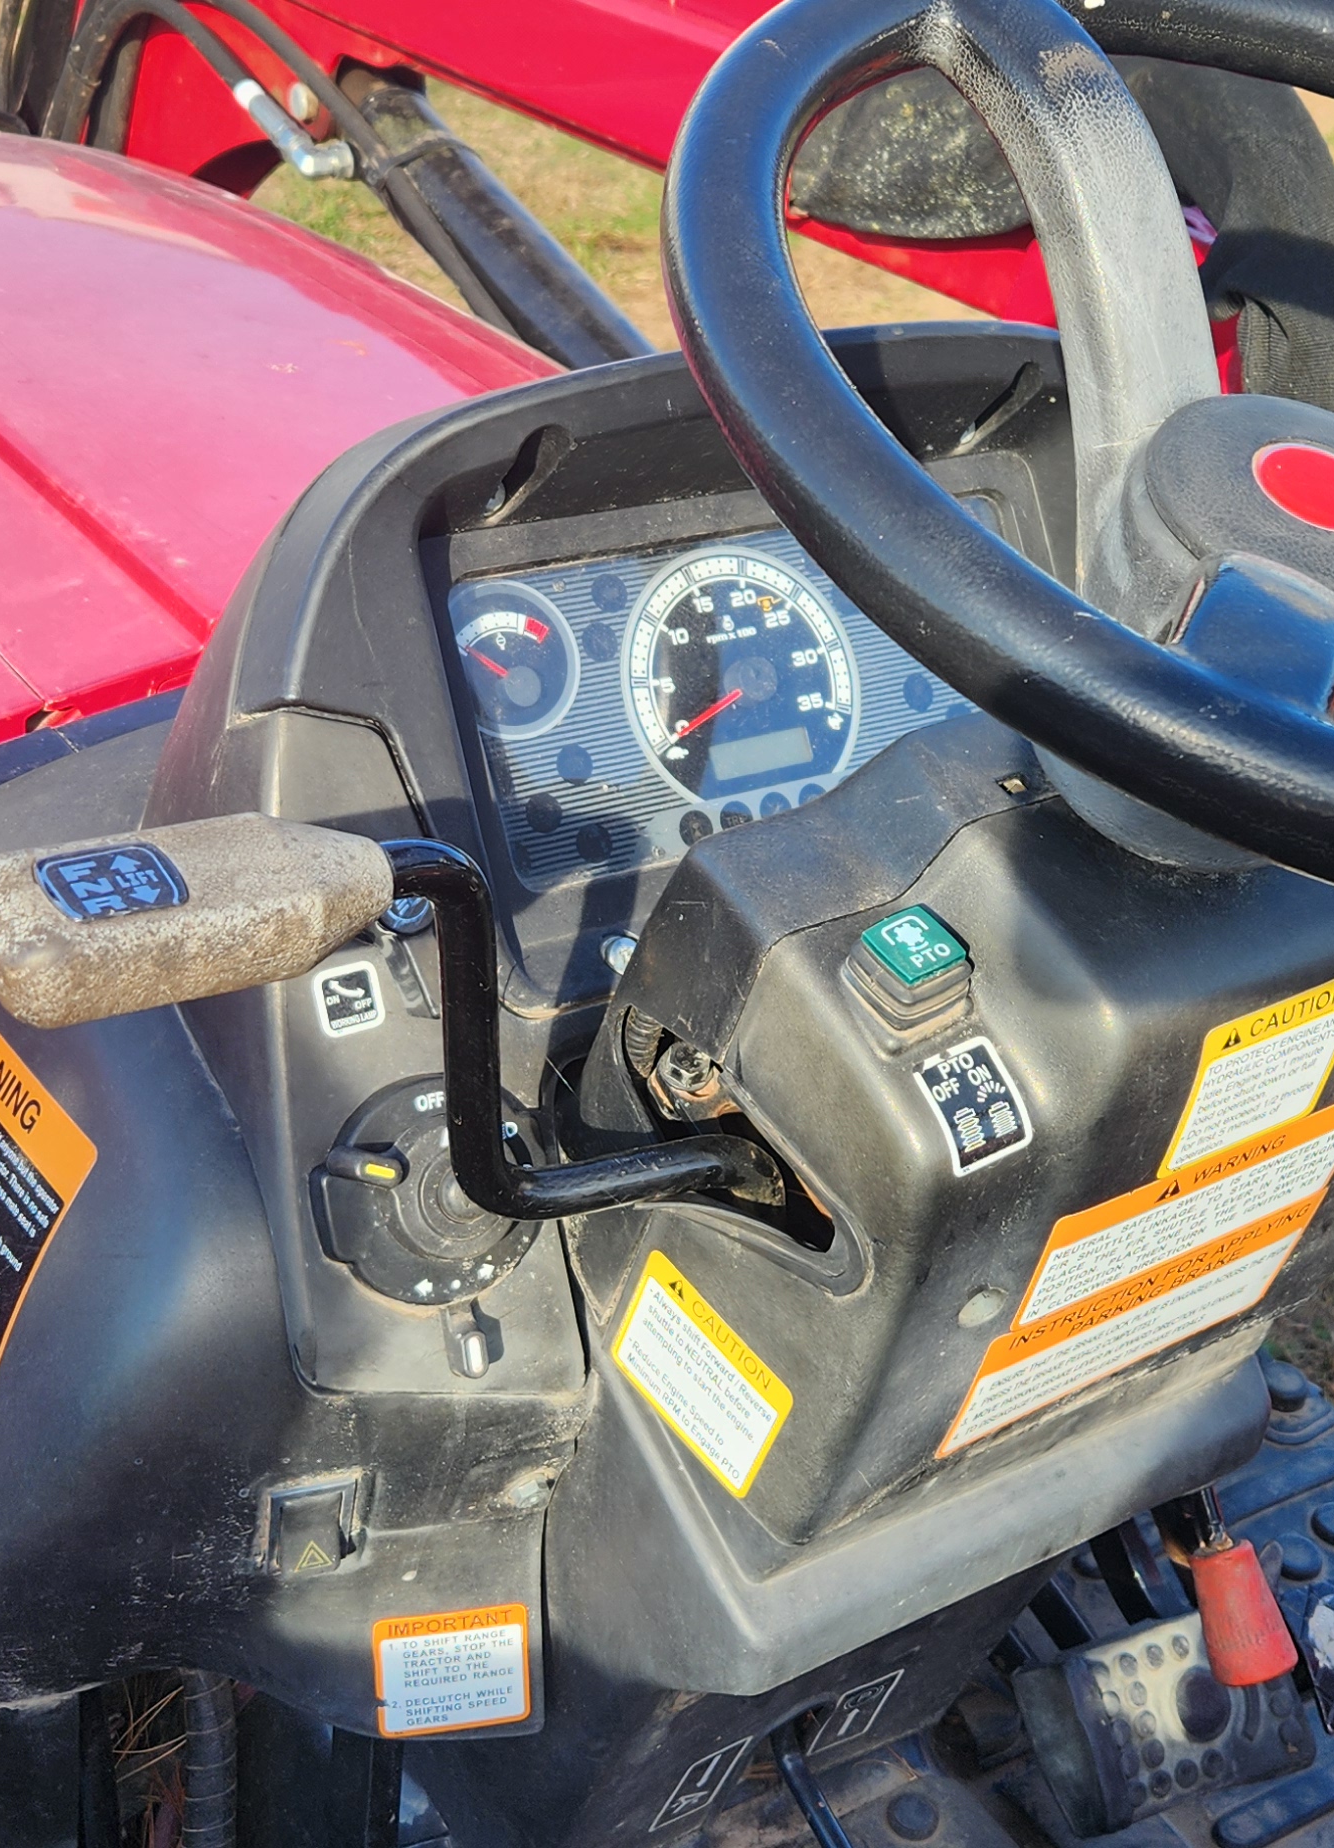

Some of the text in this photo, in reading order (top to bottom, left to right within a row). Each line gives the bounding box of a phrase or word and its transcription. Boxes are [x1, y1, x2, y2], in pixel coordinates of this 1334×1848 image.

[692, 596, 714, 613] 15
[729, 589, 757, 607] 20
[764, 609, 791, 628] 25
[668, 628, 689, 645] 10
[706, 633, 728, 645] rpm
[736, 626, 757, 638] 100
[791, 648, 817, 667] 30
[659, 677, 676, 693] 5
[797, 692, 823, 712] 35
[59, 861, 97, 882] F
[115, 869, 159, 888] LIFT
[70, 878, 114, 899] N
[82, 895, 128, 915] R
[910, 943, 951, 968] PTO
[326, 994, 340, 1006] ON
[1224, 1040, 1278, 1070] PROTECT
[1279, 1022, 1322, 1047] ENGINE
[937, 1053, 974, 1080] PTO
[967, 1063, 992, 1086] ON
[1201, 1057, 1264, 1090] HYDRAULIC
[932, 1077, 960, 1102] OFF
[413, 1090, 445, 1112] OFF
[1189, 1133, 1287, 1186] WARNING
[1051, 1229, 1113, 1263] NEUTRAL
[1120, 1205, 1169, 1233] SAFETY
[1175, 1182, 1223, 1209] SWITCH
[1247, 1140, 1320, 1178] CONNECTED
[1076, 1229, 1134, 1261] SHUTTLE
[1229, 1172, 1267, 1195] START
[1274, 1159, 1297, 1175] THE
[1041, 1260, 1086, 1286] PLACE
[1092, 1246, 1117, 1263] THE
[1152, 1207, 1207, 1237] SHUTTLE
[1214, 1187, 1253, 1210] LEVER
[1278, 1152, 1330, 1181] NEUTRAL
[1107, 1241, 1150, 1266] PLACE
[1156, 1227, 1182, 1245] ONE
[1213, 1203, 1236, 1219] THE
[1242, 1189, 1267, 1206] PTO
[1272, 1167, 1317, 1192] SWITCH
[1030, 1291, 1057, 1308] OFF
[1134, 1242, 1167, 1263] THEN
[1174, 1224, 1207, 1245] TURN
[1213, 1211, 1237, 1227] THE
[1242, 1186, 1293, 1214] IGNITION
[1299, 1172, 1323, 1188] KEY
[1007, 1201, 1313, 1351] INSTRUCTION FOR APPLYING
[1046, 1270, 1122, 1311] CLOCKWISE
[1066, 1246, 1245, 1336] PARKING BRAKE
[690, 1298, 772, 1391] CAUTION
[641, 1315, 683, 1366] attempting
[692, 1371, 712, 1396] start
[711, 1392, 726, 1411] the
[647, 1303, 675, 1336] shuttle
[683, 1343, 724, 1390] NEUTRAL
[724, 1386, 750, 1419] before
[652, 1290, 682, 1327] Always
[681, 1321, 701, 1346] shift
[700, 1341, 735, 1382] Forward
[738, 1382, 772, 1423] Reverse
[631, 1340, 661, 1376] Reduce
[660, 1372, 689, 1409] Engine
[688, 1403, 714, 1437] Speed
[626, 1351, 664, 1397] Minimum
[661, 1391, 681, 1416] RPM
[689, 1423, 721, 1462] Engage
[388, 1609, 511, 1637] IMPORTANT
[423, 1636, 457, 1646] SHIFT
[464, 1629, 505, 1641] RANGE
[454, 1642, 485, 1652] STOP
[491, 1638, 512, 1647] THE
[403, 1651, 491, 1668] TRACTOR AND
[404, 1667, 438, 1678] SHIFT
[466, 1660, 488, 1670] THE
[404, 1667, 513, 1688] REQUIRED RANGE
[405, 1691, 470, 1707] DECLUTCH
[477, 1686, 512, 1697] WHILE
[406, 1696, 506, 1717] SHIFTING SPEED
[406, 1714, 448, 1726] GEARS
